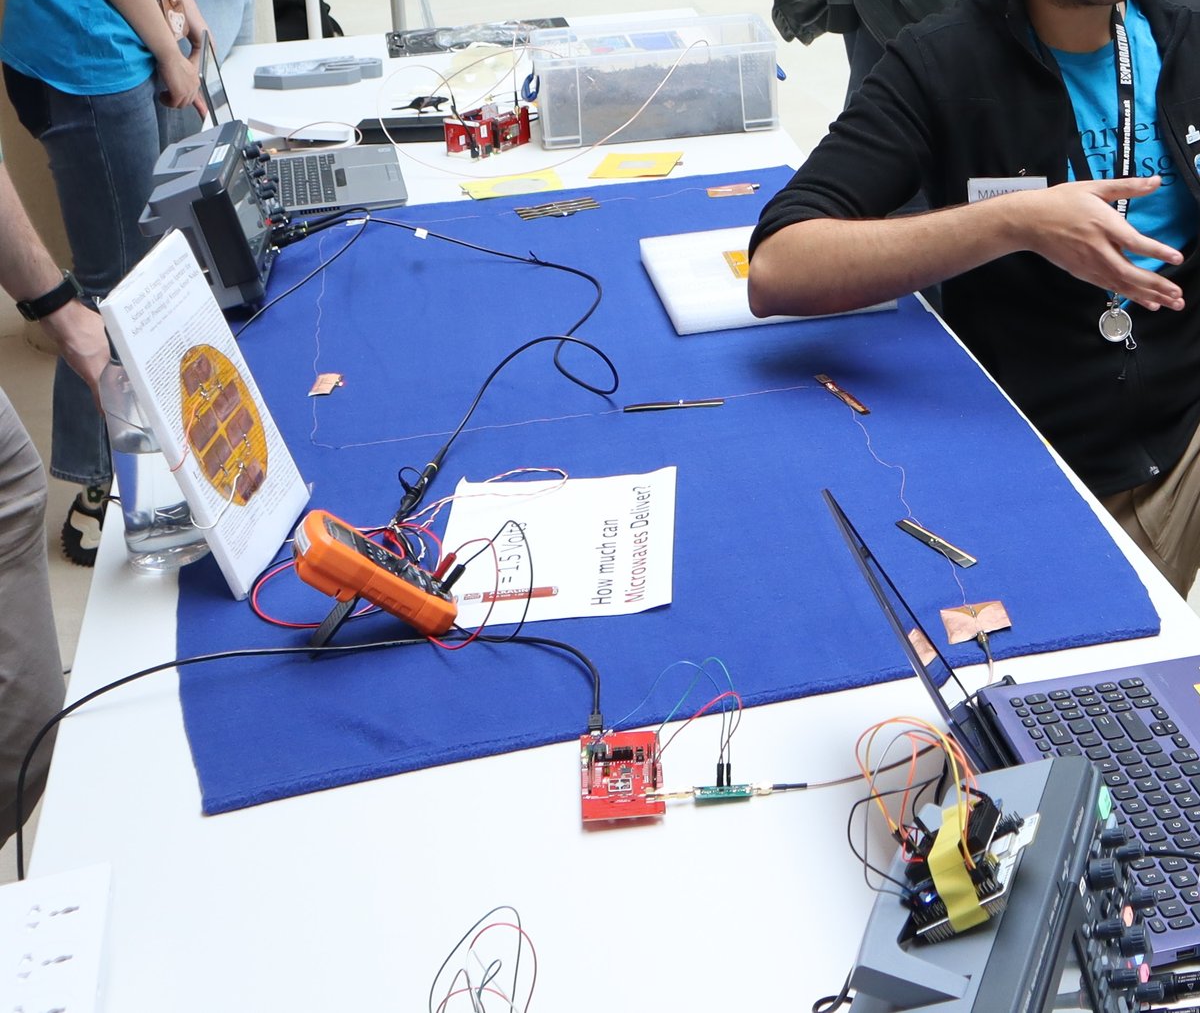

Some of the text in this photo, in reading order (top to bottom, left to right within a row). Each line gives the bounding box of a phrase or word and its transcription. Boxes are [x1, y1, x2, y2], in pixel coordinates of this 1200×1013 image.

[1115, 23, 1132, 85] EXPLORATHON
[1122, 100, 1131, 176] www.explorathon.co.uk
[498, 554, 521, 572] 1.5
[500, 522, 527, 552] Volts
[590, 519, 619, 606] How much can
[624, 485, 651, 603] Microwaves Deliver?
